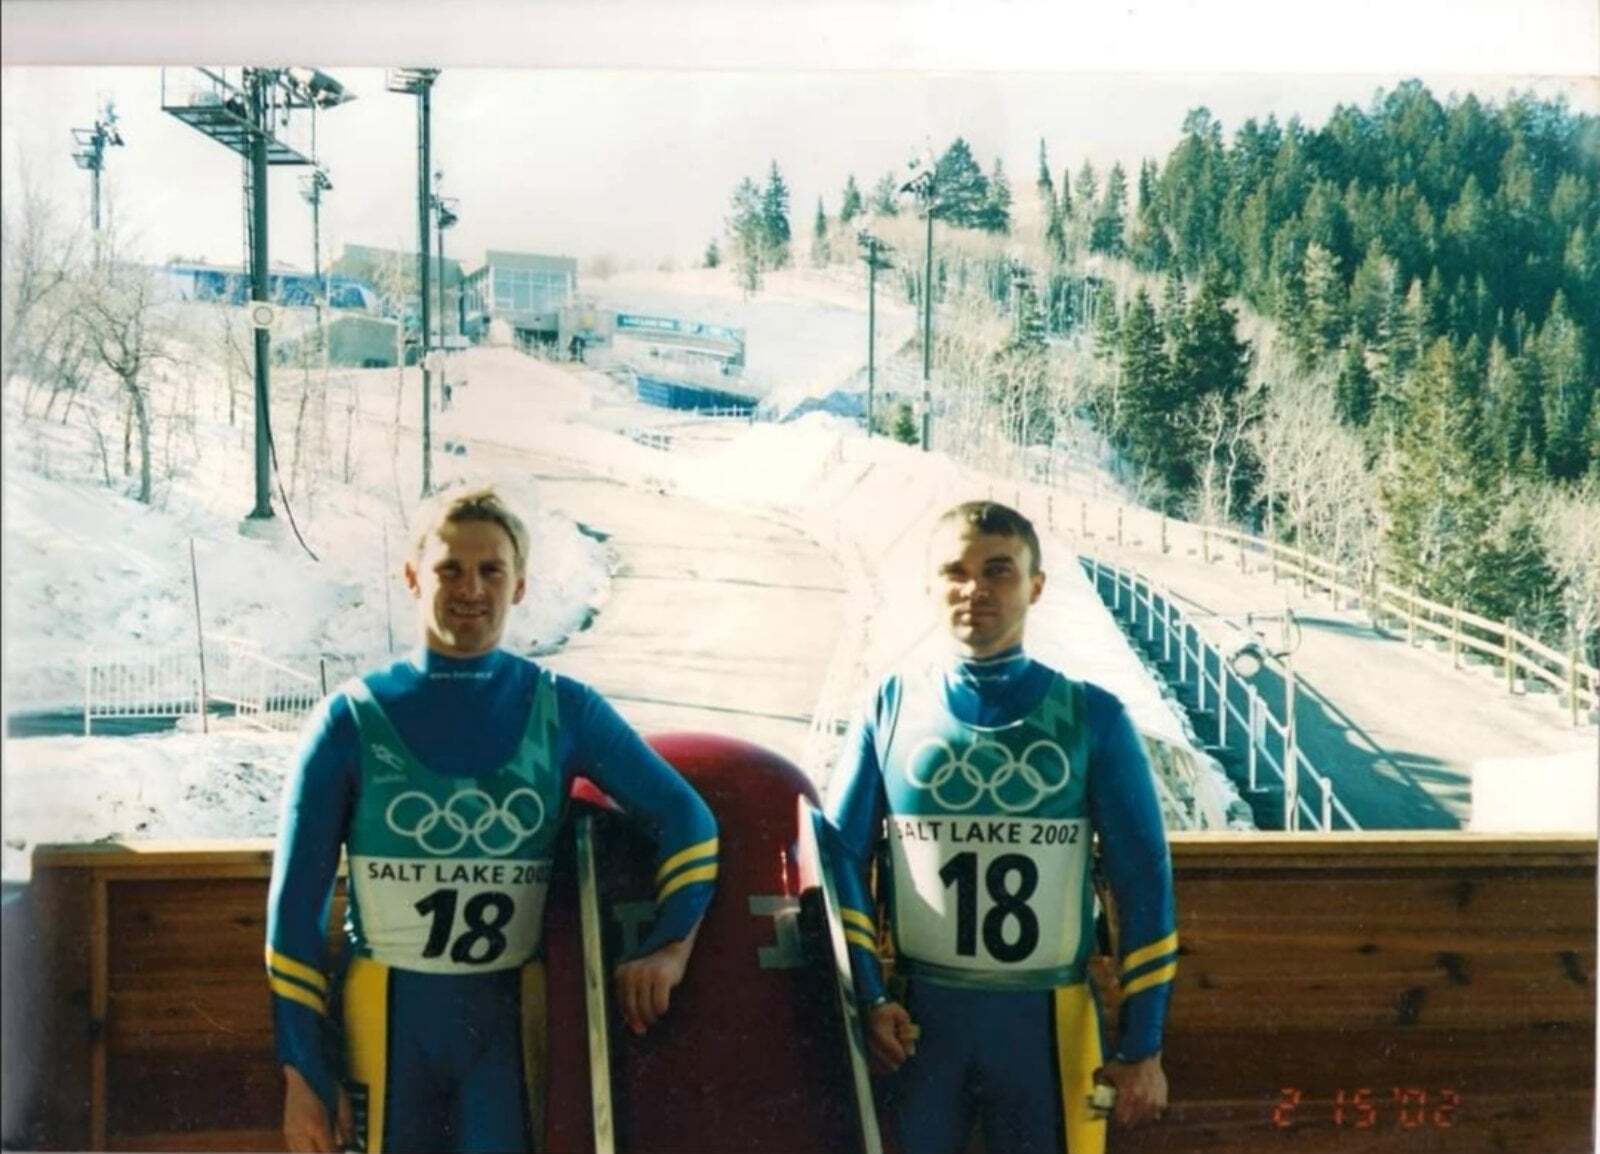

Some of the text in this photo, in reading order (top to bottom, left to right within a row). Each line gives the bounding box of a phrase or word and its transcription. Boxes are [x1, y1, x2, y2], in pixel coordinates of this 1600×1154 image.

[951, 822, 1022, 844] LAKE
[1030, 824, 1080, 845] 2002
[368, 862, 427, 883] SALT
[435, 864, 505, 884] LAKE
[414, 888, 516, 965] 18
[938, 851, 1040, 963] 18
